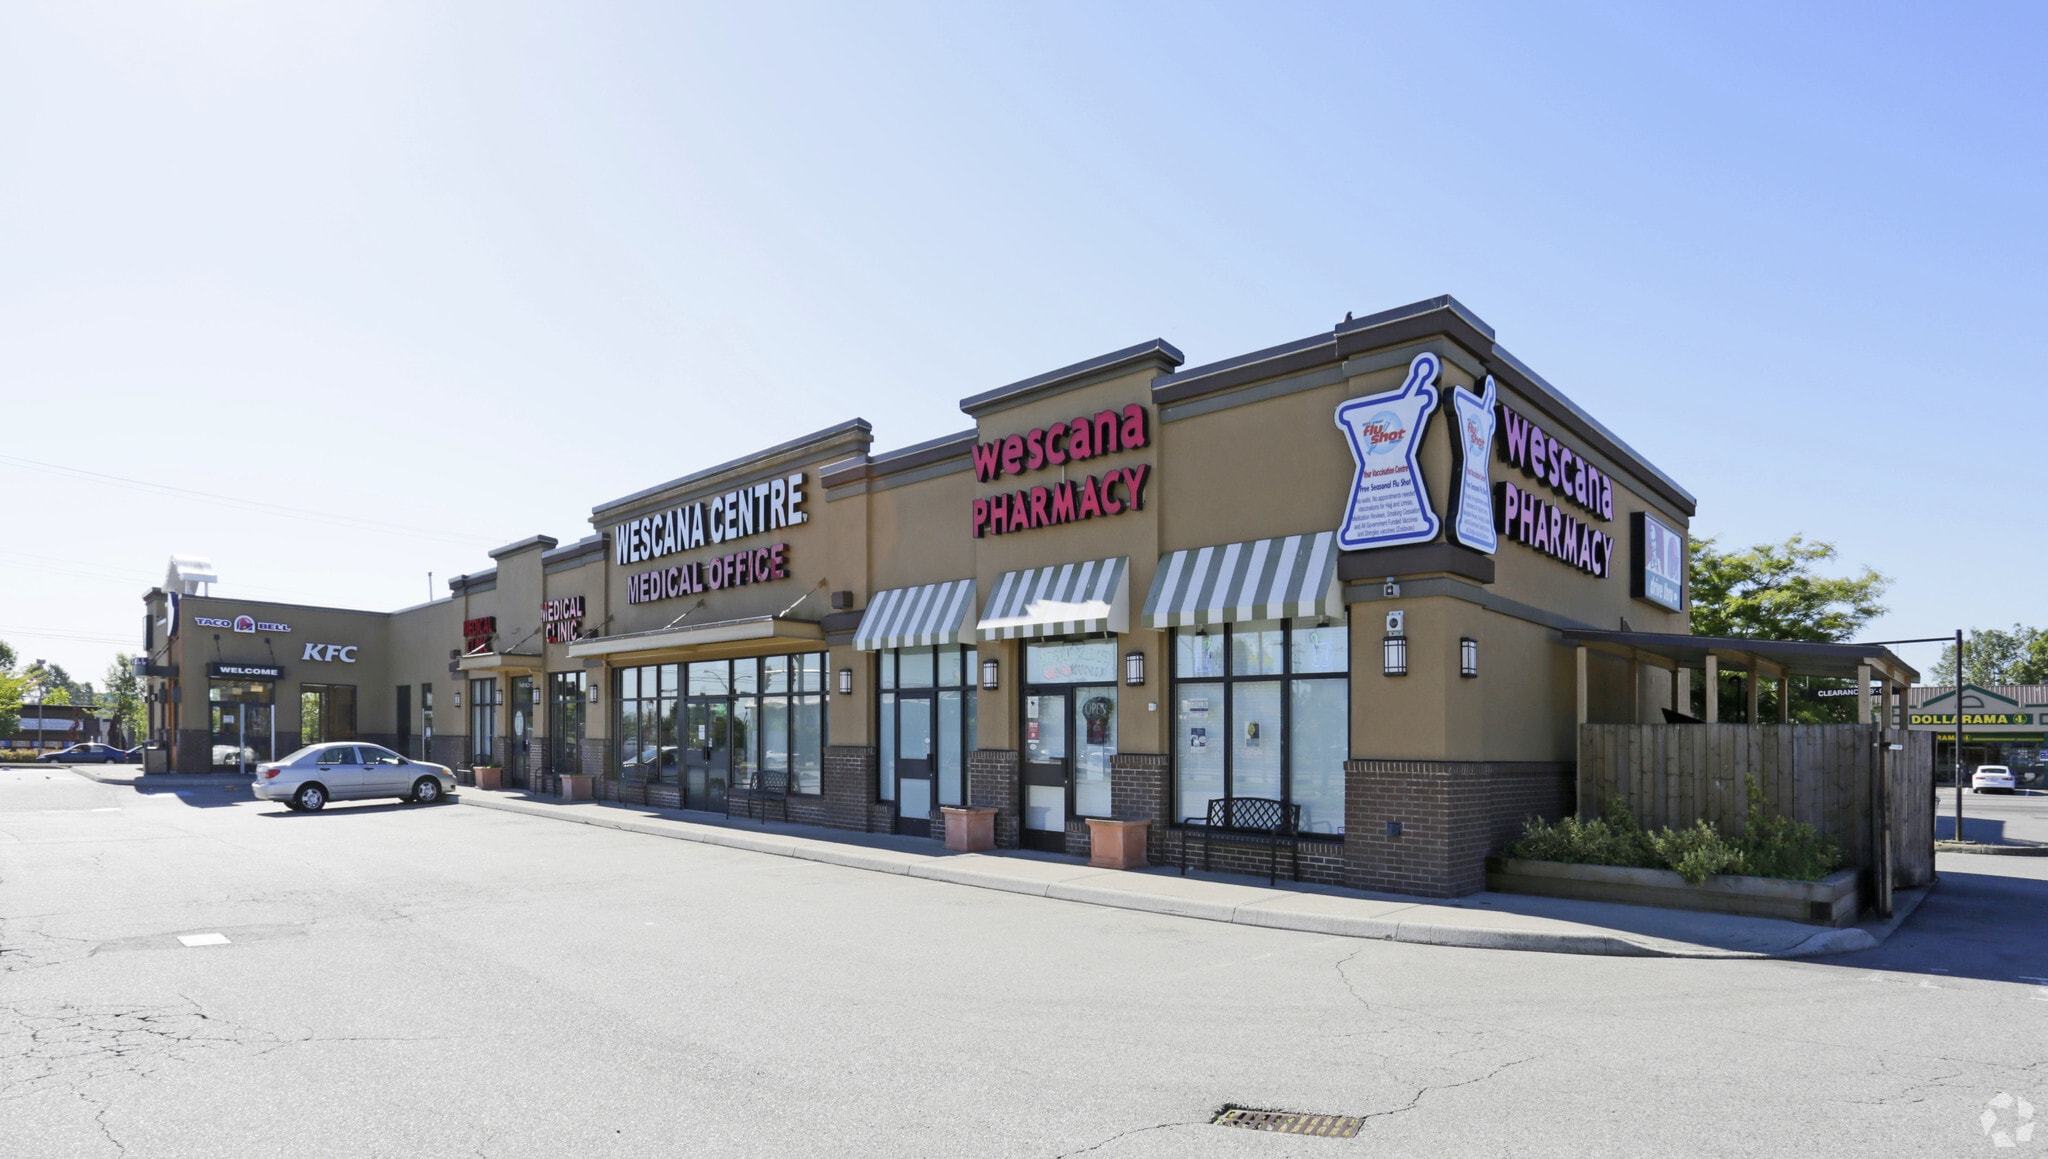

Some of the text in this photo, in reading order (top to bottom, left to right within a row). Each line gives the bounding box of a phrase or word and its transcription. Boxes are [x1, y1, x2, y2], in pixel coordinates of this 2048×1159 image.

[972, 463, 1147, 539] PHARMACY
[615, 472, 803, 566] WESCANA CENTRE
[1505, 481, 1615, 579] PHARMACY
[627, 543, 785, 605] MEDICAL OFFICE
[540, 595, 582, 622] MEDICAL
[194, 617, 291, 633] TACO BELL
[545, 620, 577, 645] CLINIC
[301, 642, 358, 663] KFC
[219, 666, 278, 676] WELCOME
[1817, 689, 1859, 697] CLEARANC
